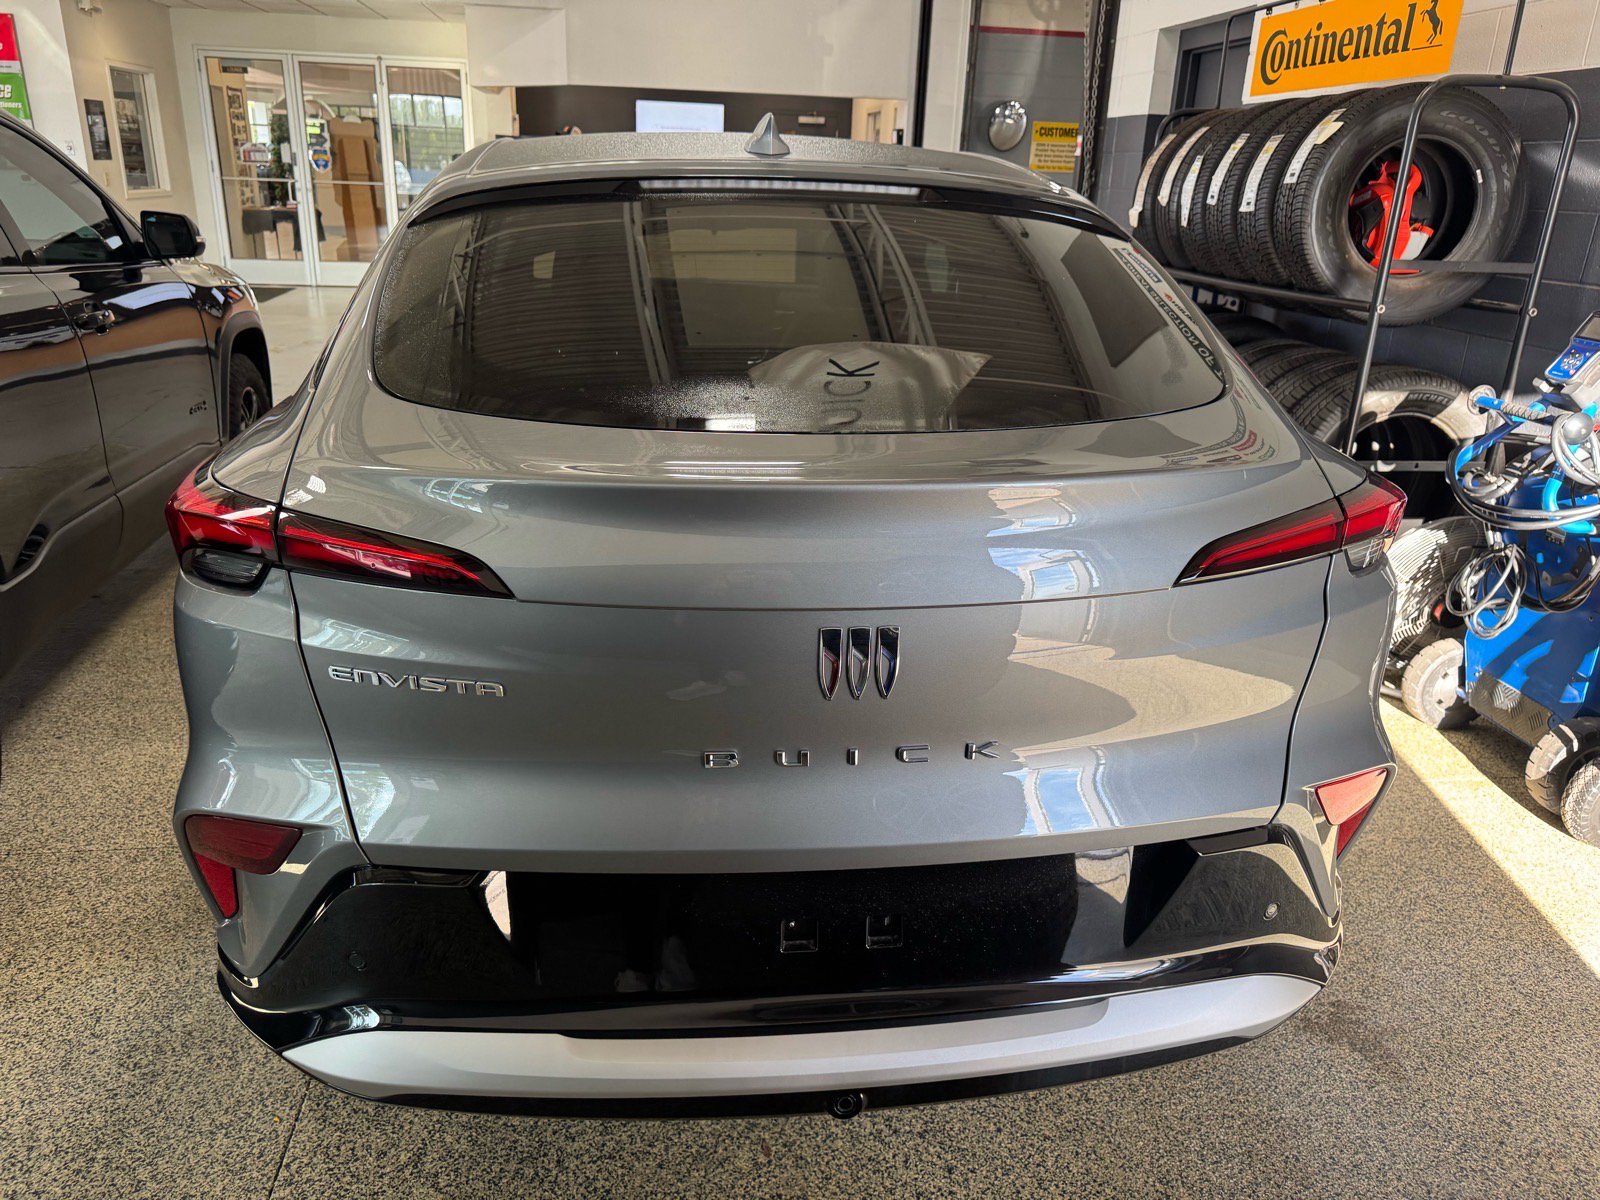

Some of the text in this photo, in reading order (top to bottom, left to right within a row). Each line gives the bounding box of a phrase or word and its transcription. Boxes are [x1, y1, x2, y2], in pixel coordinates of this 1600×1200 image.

[1260, 2, 1417, 86] Continental
[818, 358, 880, 432] UICK
[1407, 393, 1452, 406] MICHEL
[328, 665, 504, 697] ENVISTA
[704, 740, 1000, 769] BUICK
